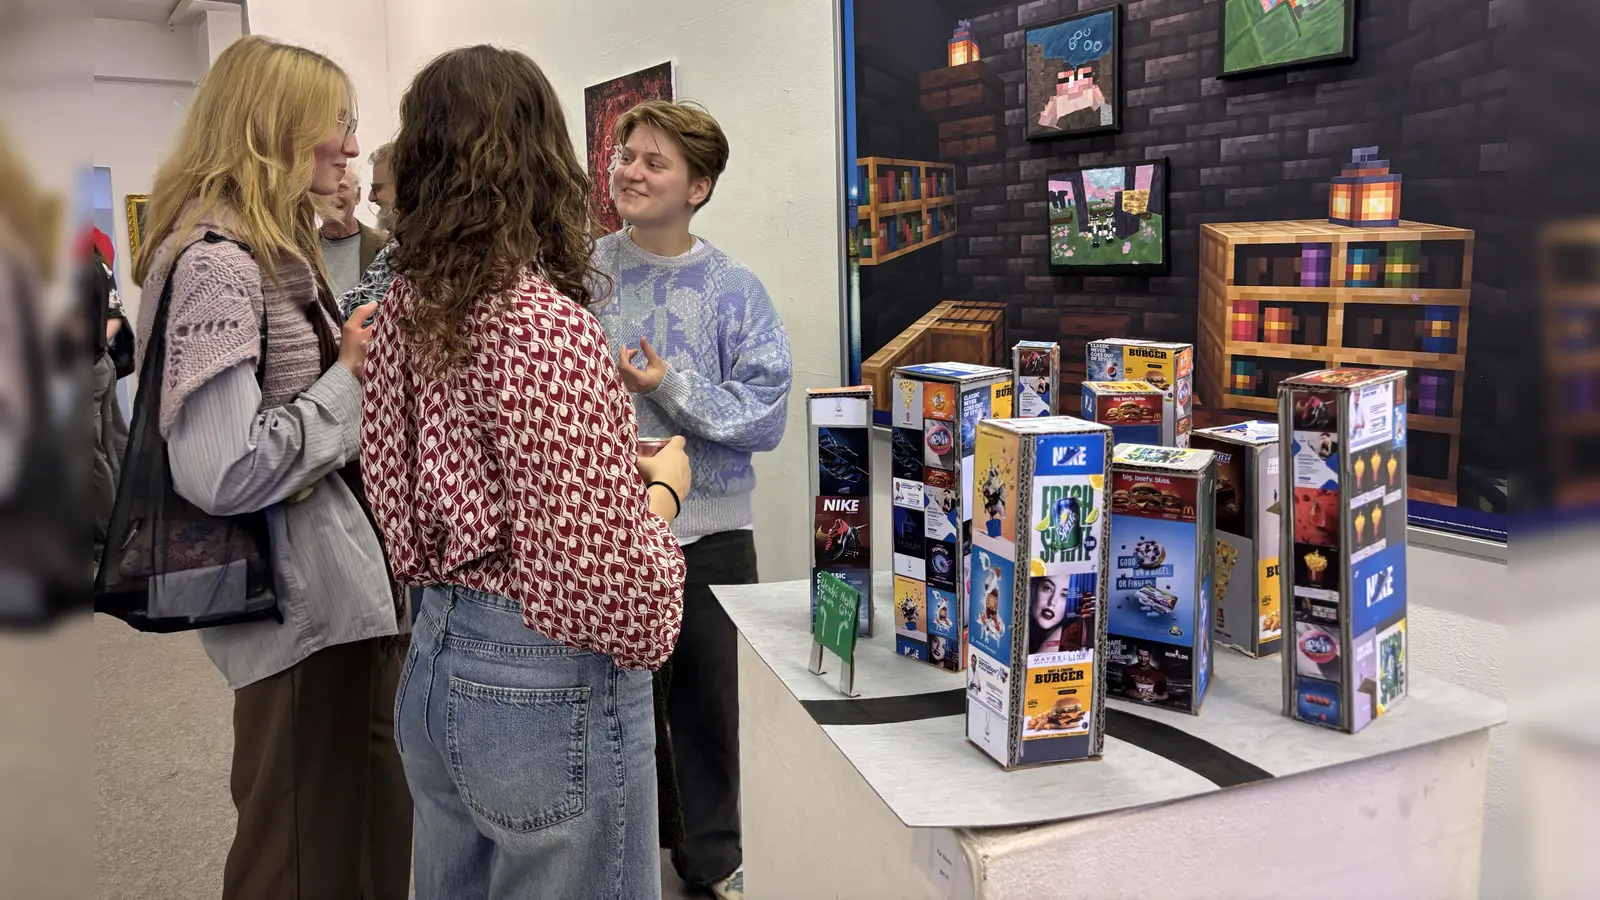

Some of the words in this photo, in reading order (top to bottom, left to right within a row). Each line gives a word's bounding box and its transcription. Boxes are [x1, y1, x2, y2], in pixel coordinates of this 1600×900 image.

[1129, 349, 1168, 359] BURGER
[964, 392, 980, 400] CLASSIC
[964, 404, 975, 412] GOES
[1155, 477, 1172, 485] bliss.
[823, 499, 860, 512] NIKE
[1119, 558, 1136, 567] GOOD
[1119, 579, 1127, 588] OR
[1034, 652, 1086, 662] MAYBELLINE
[1034, 670, 1084, 684] BURGER
